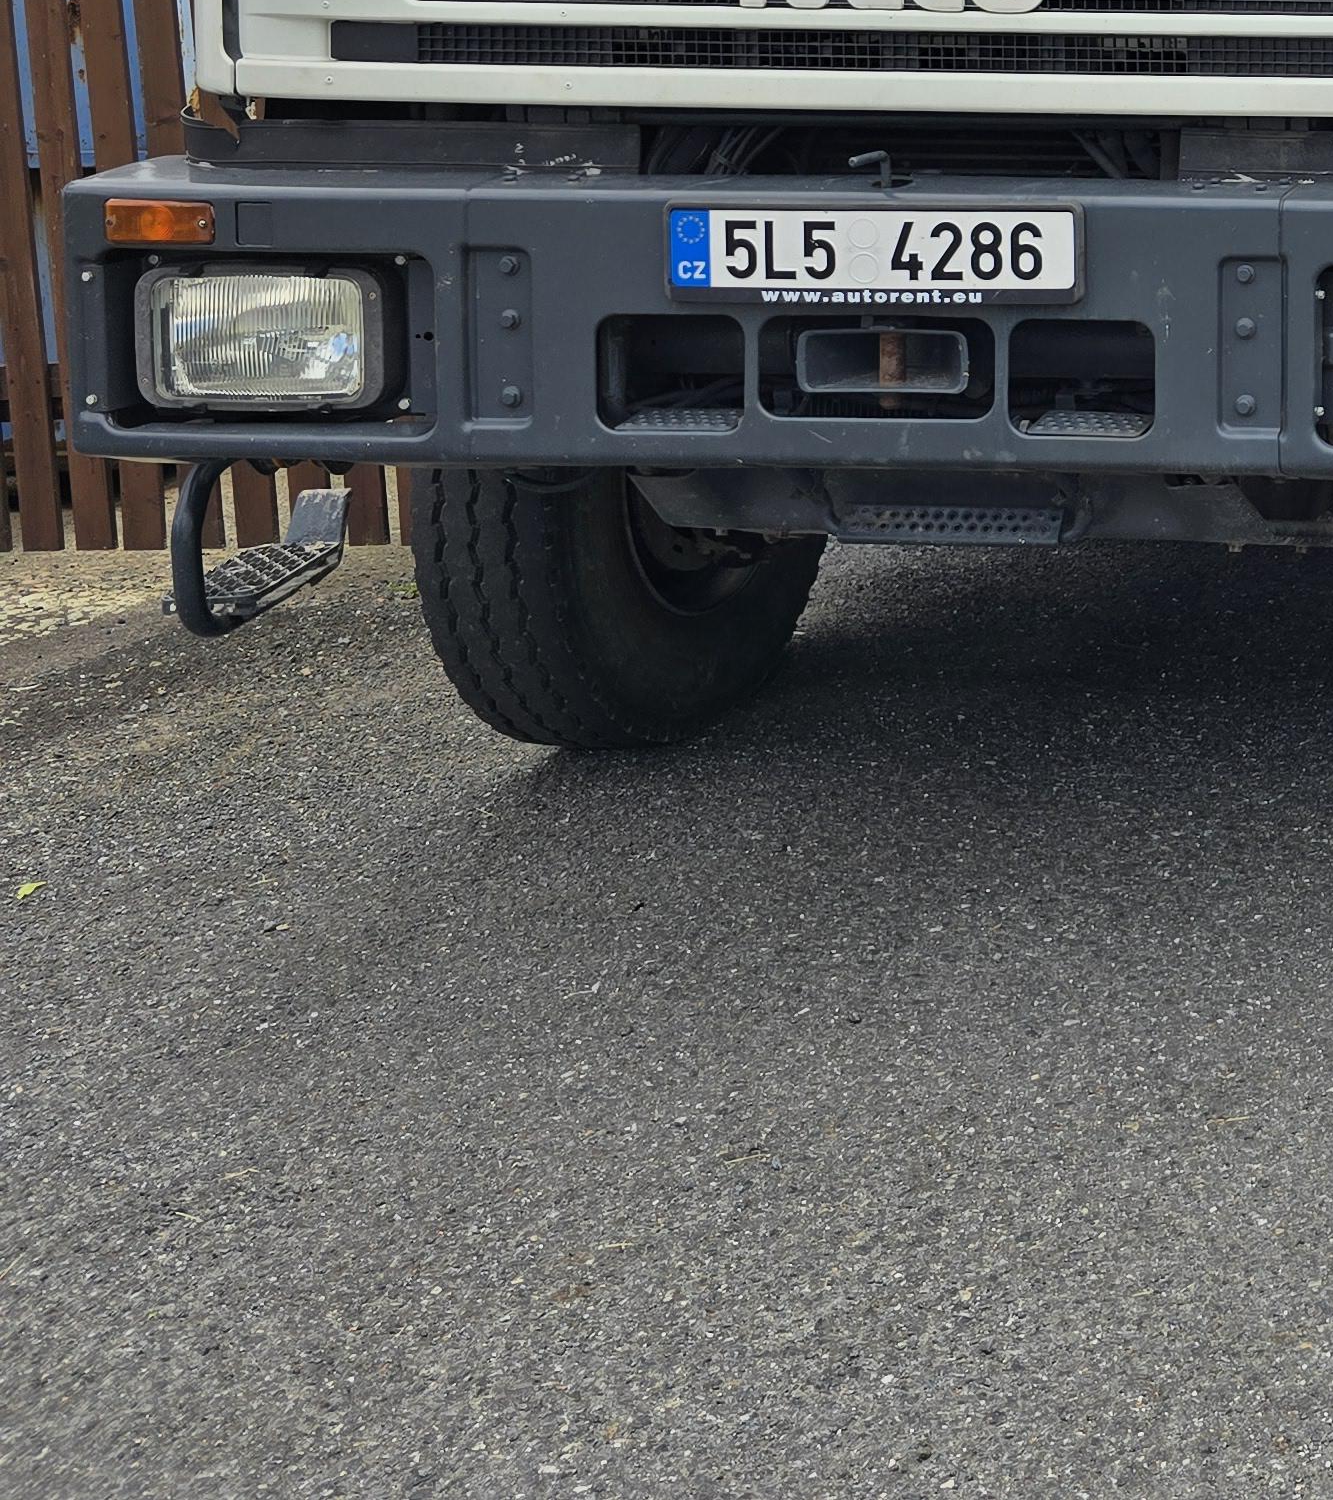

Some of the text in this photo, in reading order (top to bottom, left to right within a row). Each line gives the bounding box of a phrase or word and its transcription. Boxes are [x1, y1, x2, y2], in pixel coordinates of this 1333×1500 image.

[724, 219, 1043, 281] 5L5 4286
[678, 260, 706, 279] CZ
[762, 289, 983, 304] www.autorent.eu
